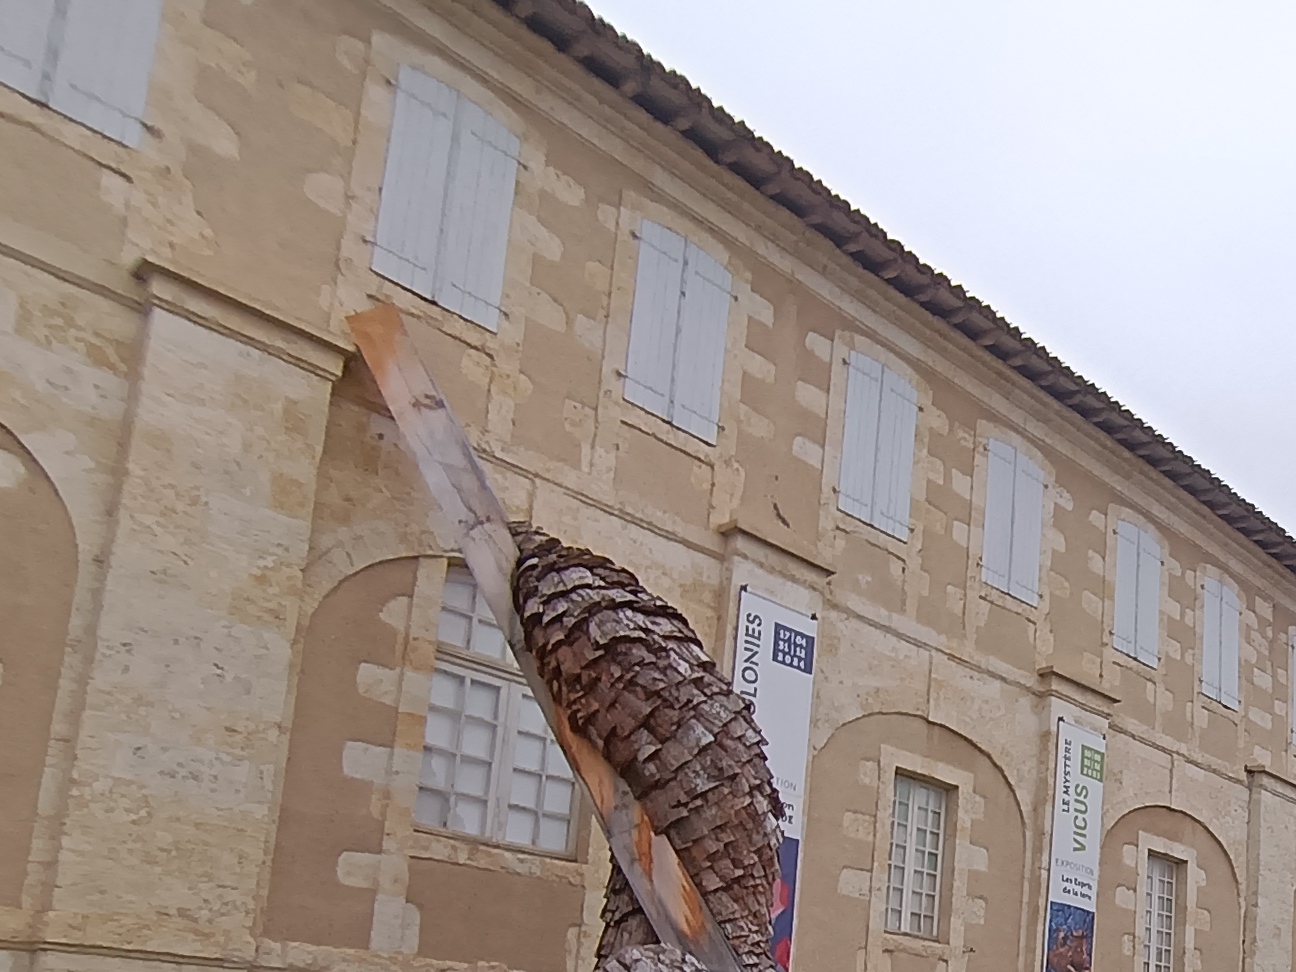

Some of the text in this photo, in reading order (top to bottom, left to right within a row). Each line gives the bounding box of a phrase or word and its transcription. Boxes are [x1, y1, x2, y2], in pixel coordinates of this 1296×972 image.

[1062, 798, 1071, 813] LE
[1072, 784, 1089, 852] VICUS
[1061, 874, 1073, 885] Les
